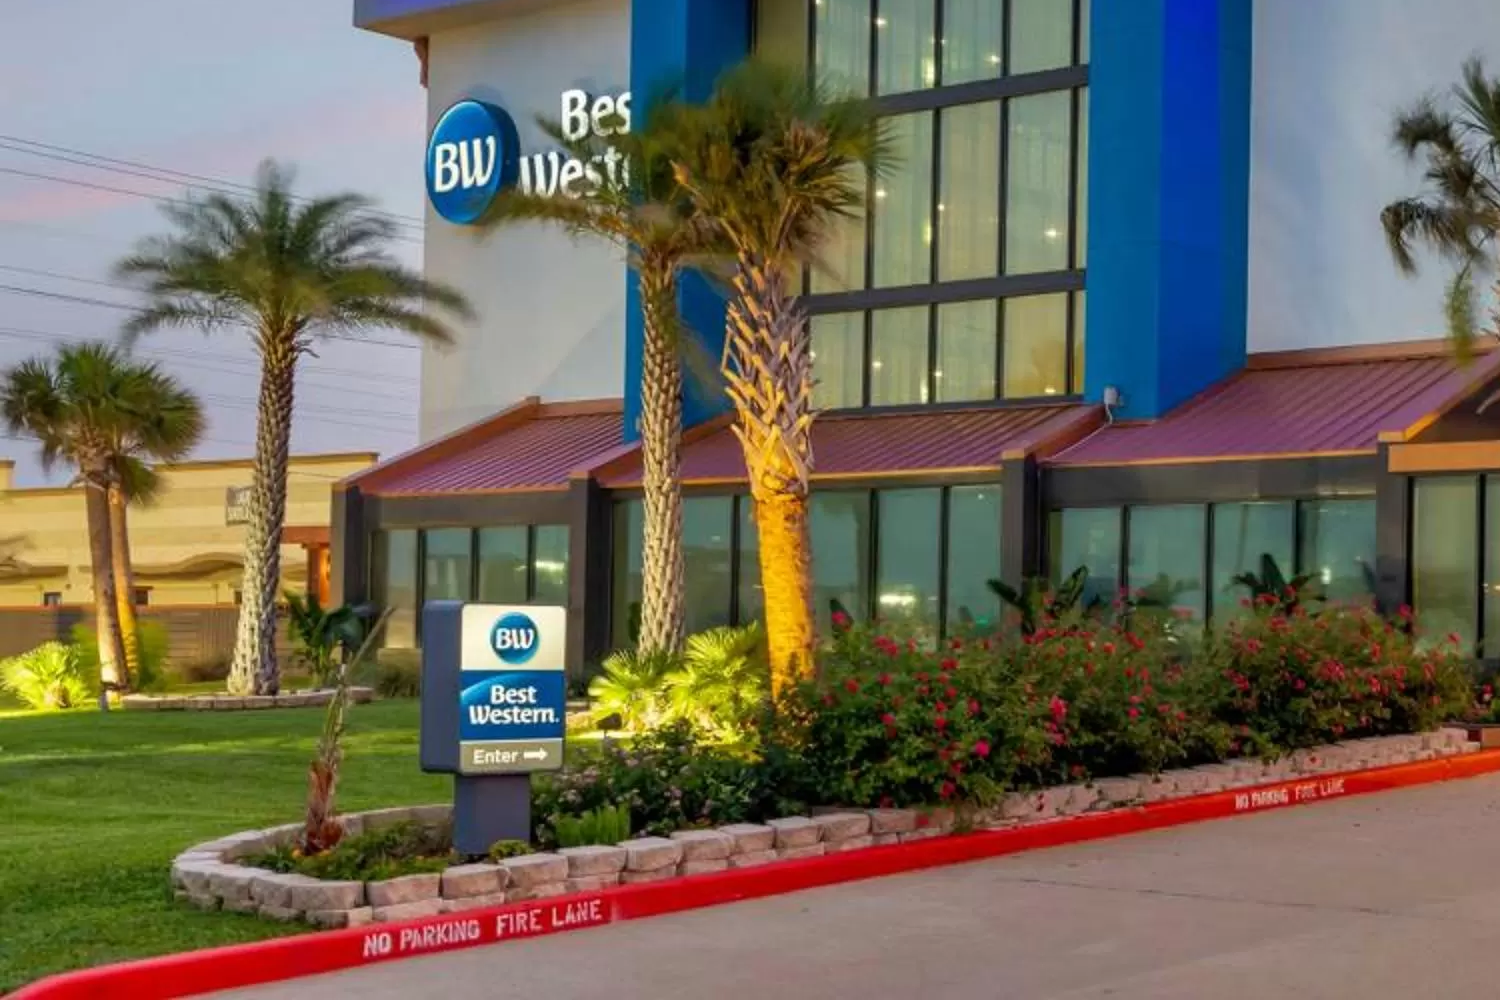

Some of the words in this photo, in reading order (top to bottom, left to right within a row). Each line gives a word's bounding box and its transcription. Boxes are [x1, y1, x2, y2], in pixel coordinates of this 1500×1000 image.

[561, 89, 632, 141] Bes
[434, 135, 496, 193] BW
[495, 627, 534, 649] BW
[491, 684, 537, 704] Best
[472, 749, 519, 765] Enter
[363, 932, 392, 957] NO
[400, 919, 480, 949] PARKING
[496, 909, 542, 935] FIRE
[552, 899, 602, 927] LANE
